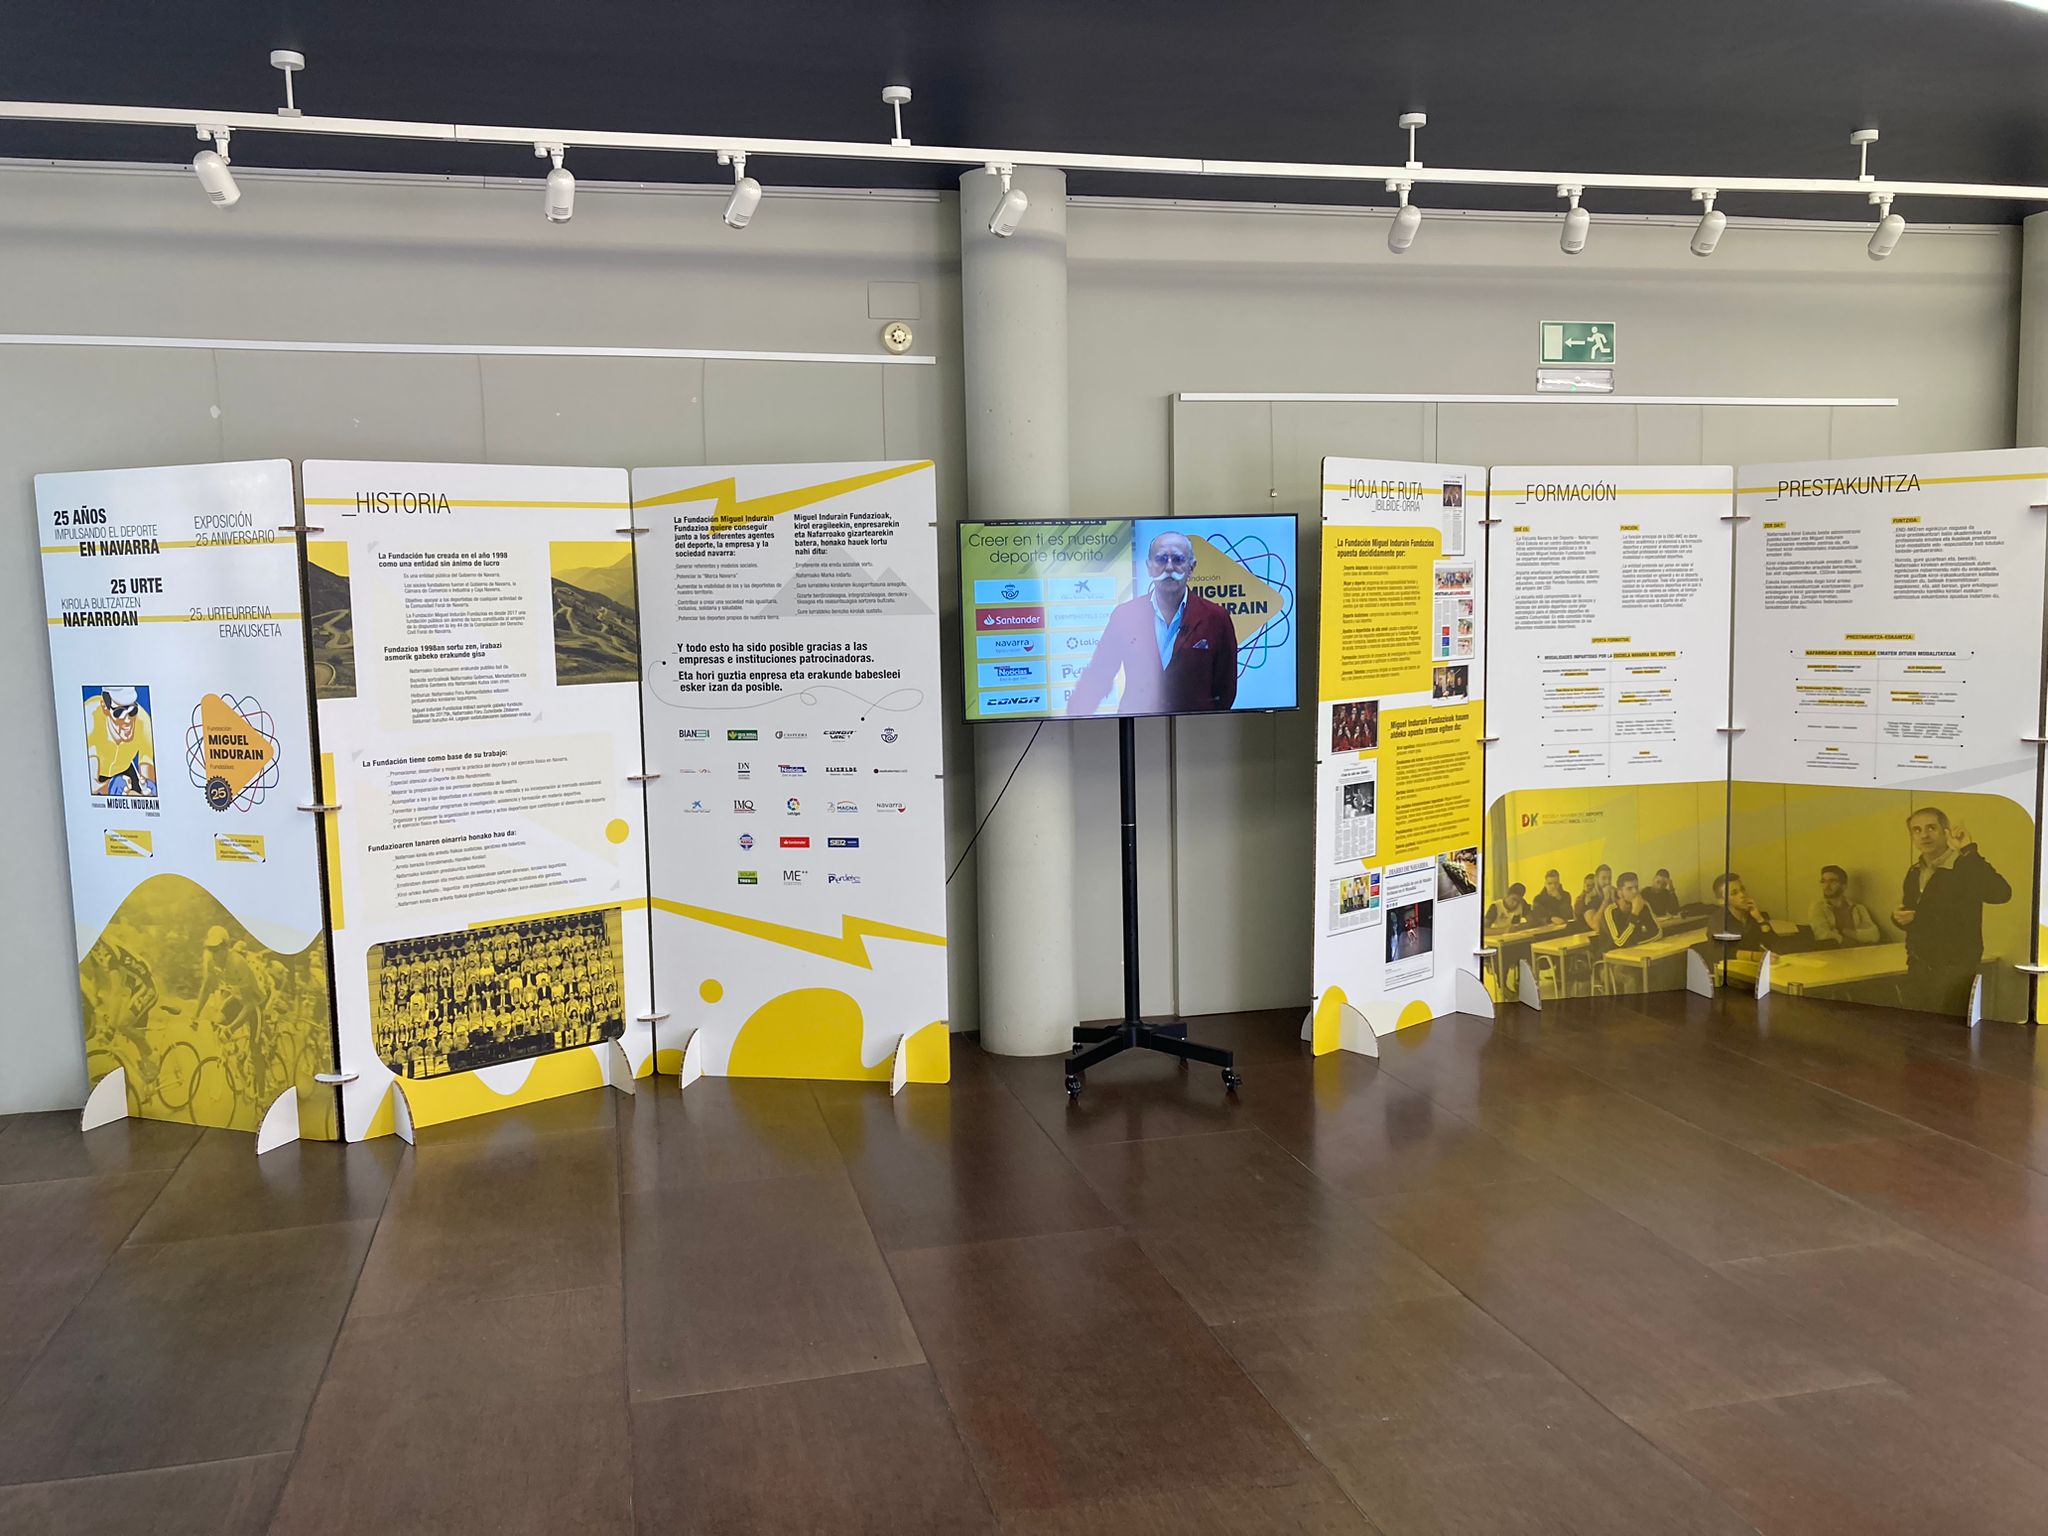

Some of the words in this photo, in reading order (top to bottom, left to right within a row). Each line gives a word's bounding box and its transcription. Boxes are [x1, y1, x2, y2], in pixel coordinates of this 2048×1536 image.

[1381, 481, 1395, 500] DE
[1398, 482, 1424, 500] RUTA
[54, 510, 70, 526] 25
[73, 505, 107, 526] AÑOS
[194, 511, 253, 529] EXPOSICIÓN
[673, 516, 682, 524] La
[683, 515, 720, 523] Fundación
[720, 515, 744, 524] Miguel
[745, 514, 774, 522] Indurain
[793, 514, 818, 522] Miguel
[818, 513, 848, 521] Indurain
[849, 512, 892, 520] Fundazioak,
[674, 524, 709, 532] Fundazioa
[709, 523, 733, 532] quiere
[733, 523, 768, 532] conseguir
[794, 521, 810, 530] kirol
[811, 522, 853, 530] eragileekin,
[853, 520, 900, 529] enpresarekin
[54, 527, 107, 540] IMPULSANDO
[108, 526, 120, 539] EL
[120, 524, 158, 538] DEPORTE
[211, 530, 275, 546] ANIVERSARIO
[674, 533, 693, 542] junto
[699, 532, 711, 540] los
[710, 532, 746, 540] diferentes
[747, 532, 775, 541] agentes
[807, 529, 846, 538] Nafarroako
[847, 529, 894, 538] gizartearekin
[674, 541, 686, 549] del
[687, 541, 716, 550] deporte,
[716, 541, 724, 549] la
[756, 541, 761, 549] y
[794, 539, 820, 547] batera,
[847, 537, 869, 546] hauek
[968, 533, 1007, 547] Creer
[1013, 534, 1032, 546] en
[1036, 533, 1044, 545] ti
[1047, 534, 1064, 546] es
[1068, 532, 1118, 545] nuestro
[80, 541, 97, 557] EN
[100, 540, 160, 555] NAVARRA
[378, 552, 387, 560] La
[388, 552, 424, 560] Fundación
[989, 551, 1048, 564] deporte
[1052, 550, 1104, 562] favorito
[111, 579, 127, 594] 25
[130, 577, 163, 594] URTE
[61, 598, 91, 610] KIROLA
[91, 596, 141, 609] BULTZATZEN
[62, 611, 139, 627] NAFARROAN
[207, 606, 271, 621] URTEURRENA
[996, 615, 1041, 625] Santander
[219, 623, 282, 638] ERAKUSKETA
[420, 644, 445, 652] 1998an
[686, 643, 707, 653] todo
[709, 643, 730, 653] esto
[732, 642, 744, 652] ha
[746, 642, 767, 652] sido
[769, 642, 804, 654] posible
[806, 642, 842, 653] gracias
[844, 643, 851, 651] a
[853, 642, 868, 651] las
[384, 653, 413, 661] asmorik
[413, 653, 439, 661] gabeko
[439, 651, 471, 659] erakunde
[471, 650, 486, 659] gisa
[679, 656, 725, 666] empresas
[727, 656, 733, 664] e
[735, 654, 797, 664] instituciones
[799, 653, 874, 665] patrocinadoras.
[696, 671, 715, 680] hori
[717, 670, 747, 682] guztia
[749, 672, 787, 682] enpresa
[790, 670, 805, 680] eta
[807, 670, 853, 680] erakunde
[855, 669, 901, 679] babesleei
[680, 682, 706, 692] esker
[708, 681, 729, 692] izan
[731, 682, 743, 692] da
[745, 681, 783, 693] posible.
[208, 735, 249, 746] MIGUEL
[209, 749, 264, 760] INDURAIN
[372, 758, 408, 767] Fundación
[483, 750, 508, 758] trabajo:
[737, 762, 750, 770] DN
[211, 787, 227, 800] 25
[106, 798, 130, 809] MIGUEL
[130, 799, 160, 810] INDURAIN
[733, 800, 756, 811] IMQ
[1521, 813, 1539, 828] DK
[368, 842, 414, 852] Fundazioaren
[414, 839, 440, 847] lanaren
[441, 835, 467, 844] oinarria
[468, 833, 492, 841] honako
